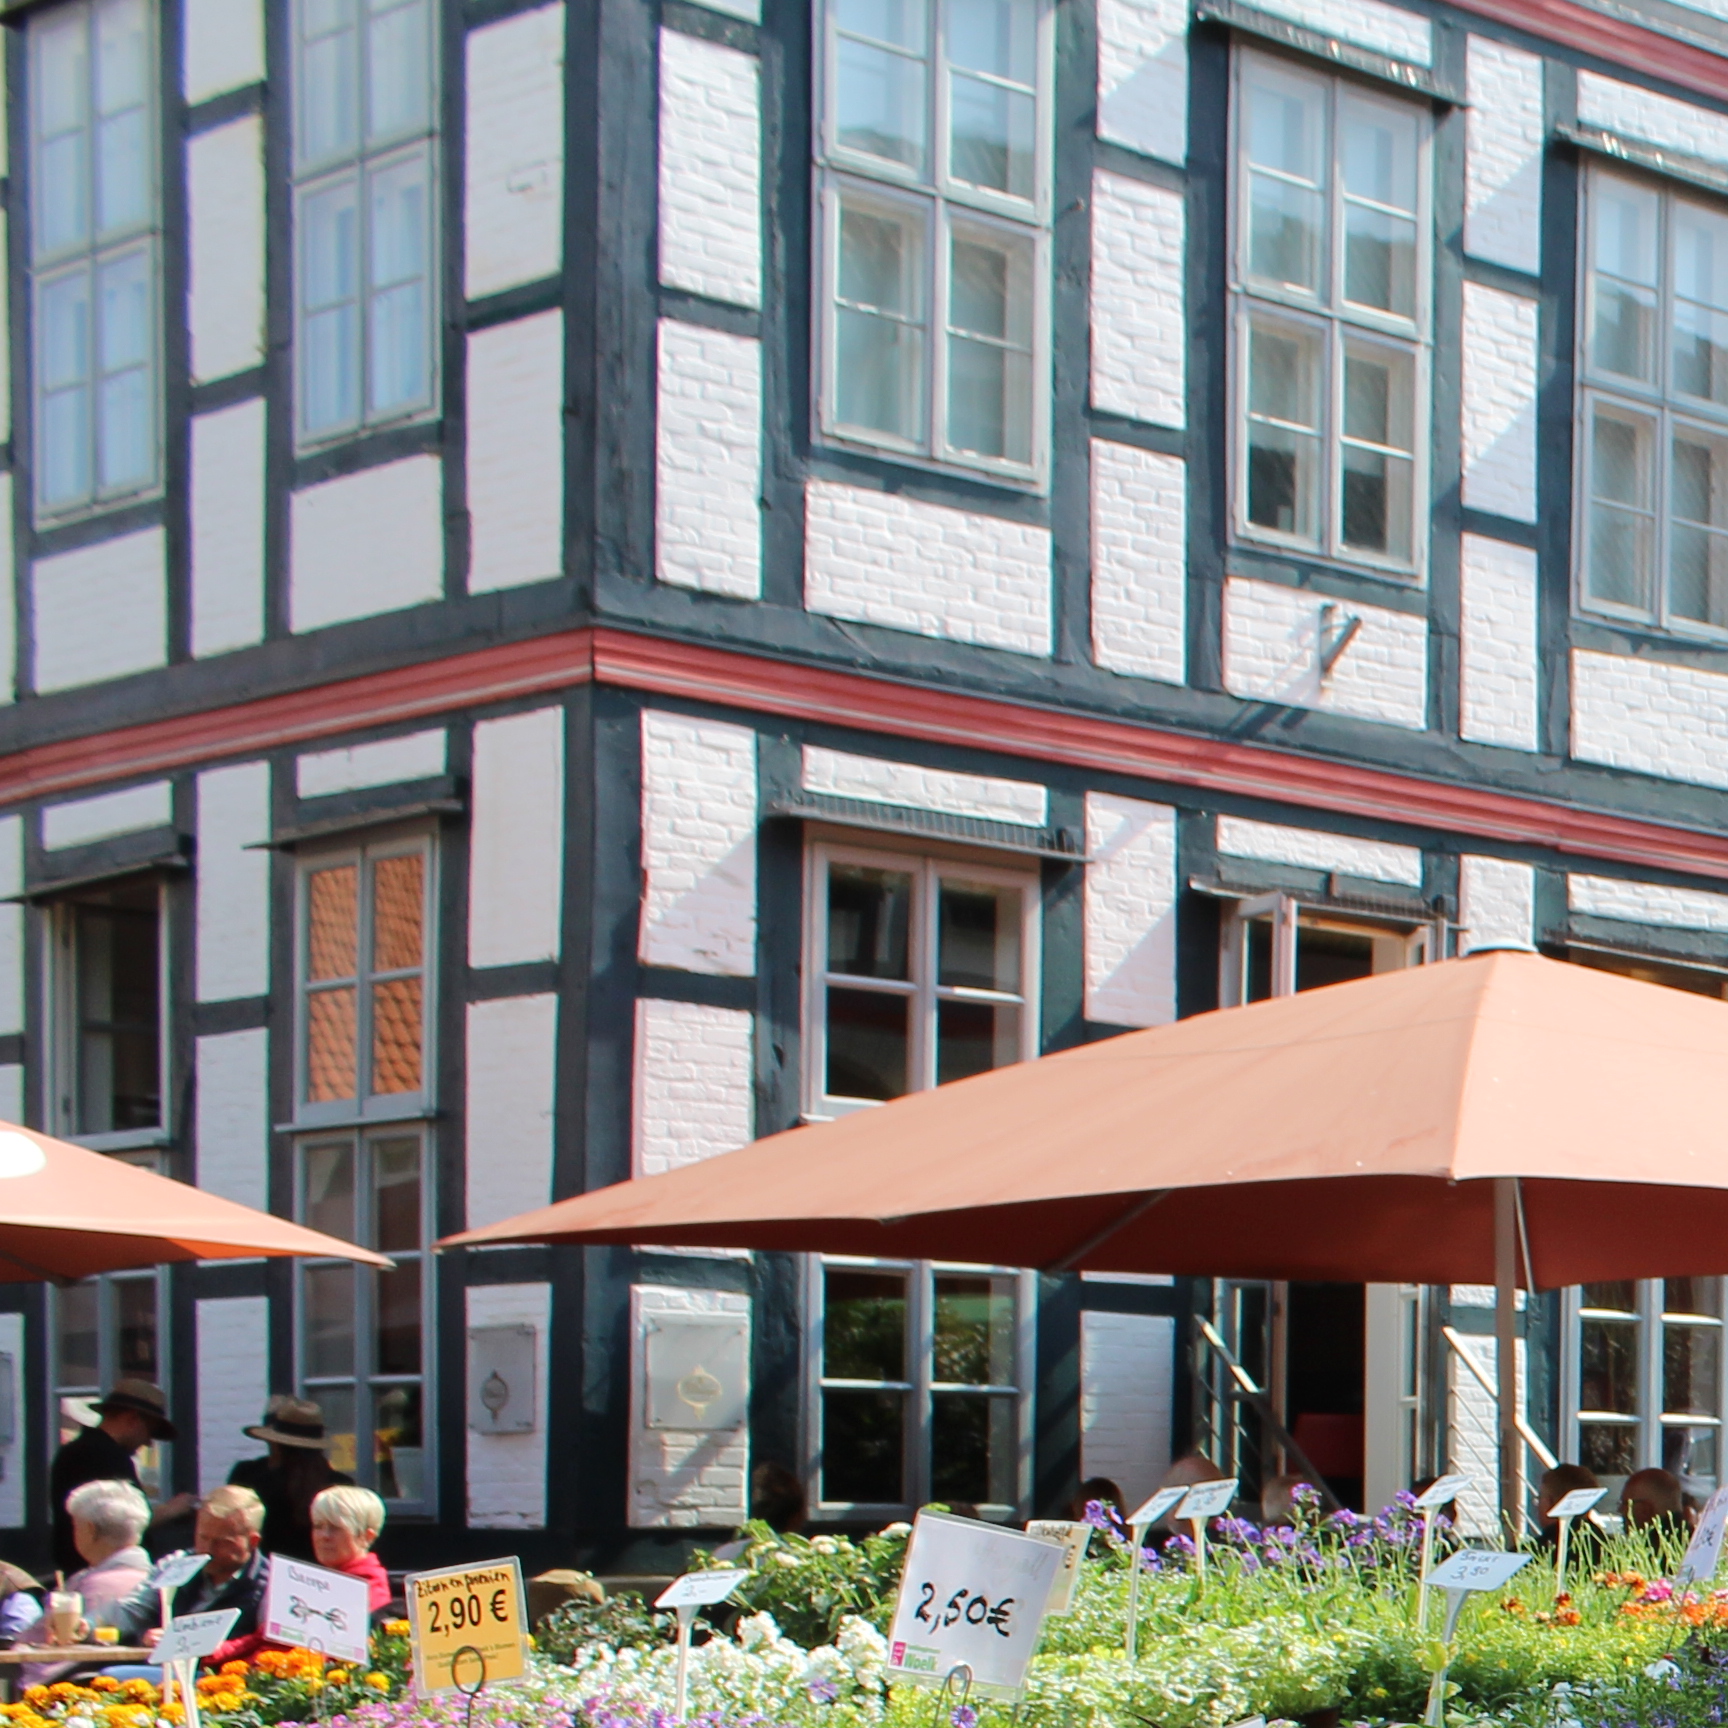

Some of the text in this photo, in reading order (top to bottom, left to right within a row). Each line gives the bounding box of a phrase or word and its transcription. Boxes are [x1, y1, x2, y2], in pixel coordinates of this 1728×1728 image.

[428, 1589, 508, 1637] 2,90 €
[914, 1581, 1015, 1637] 2,50€
